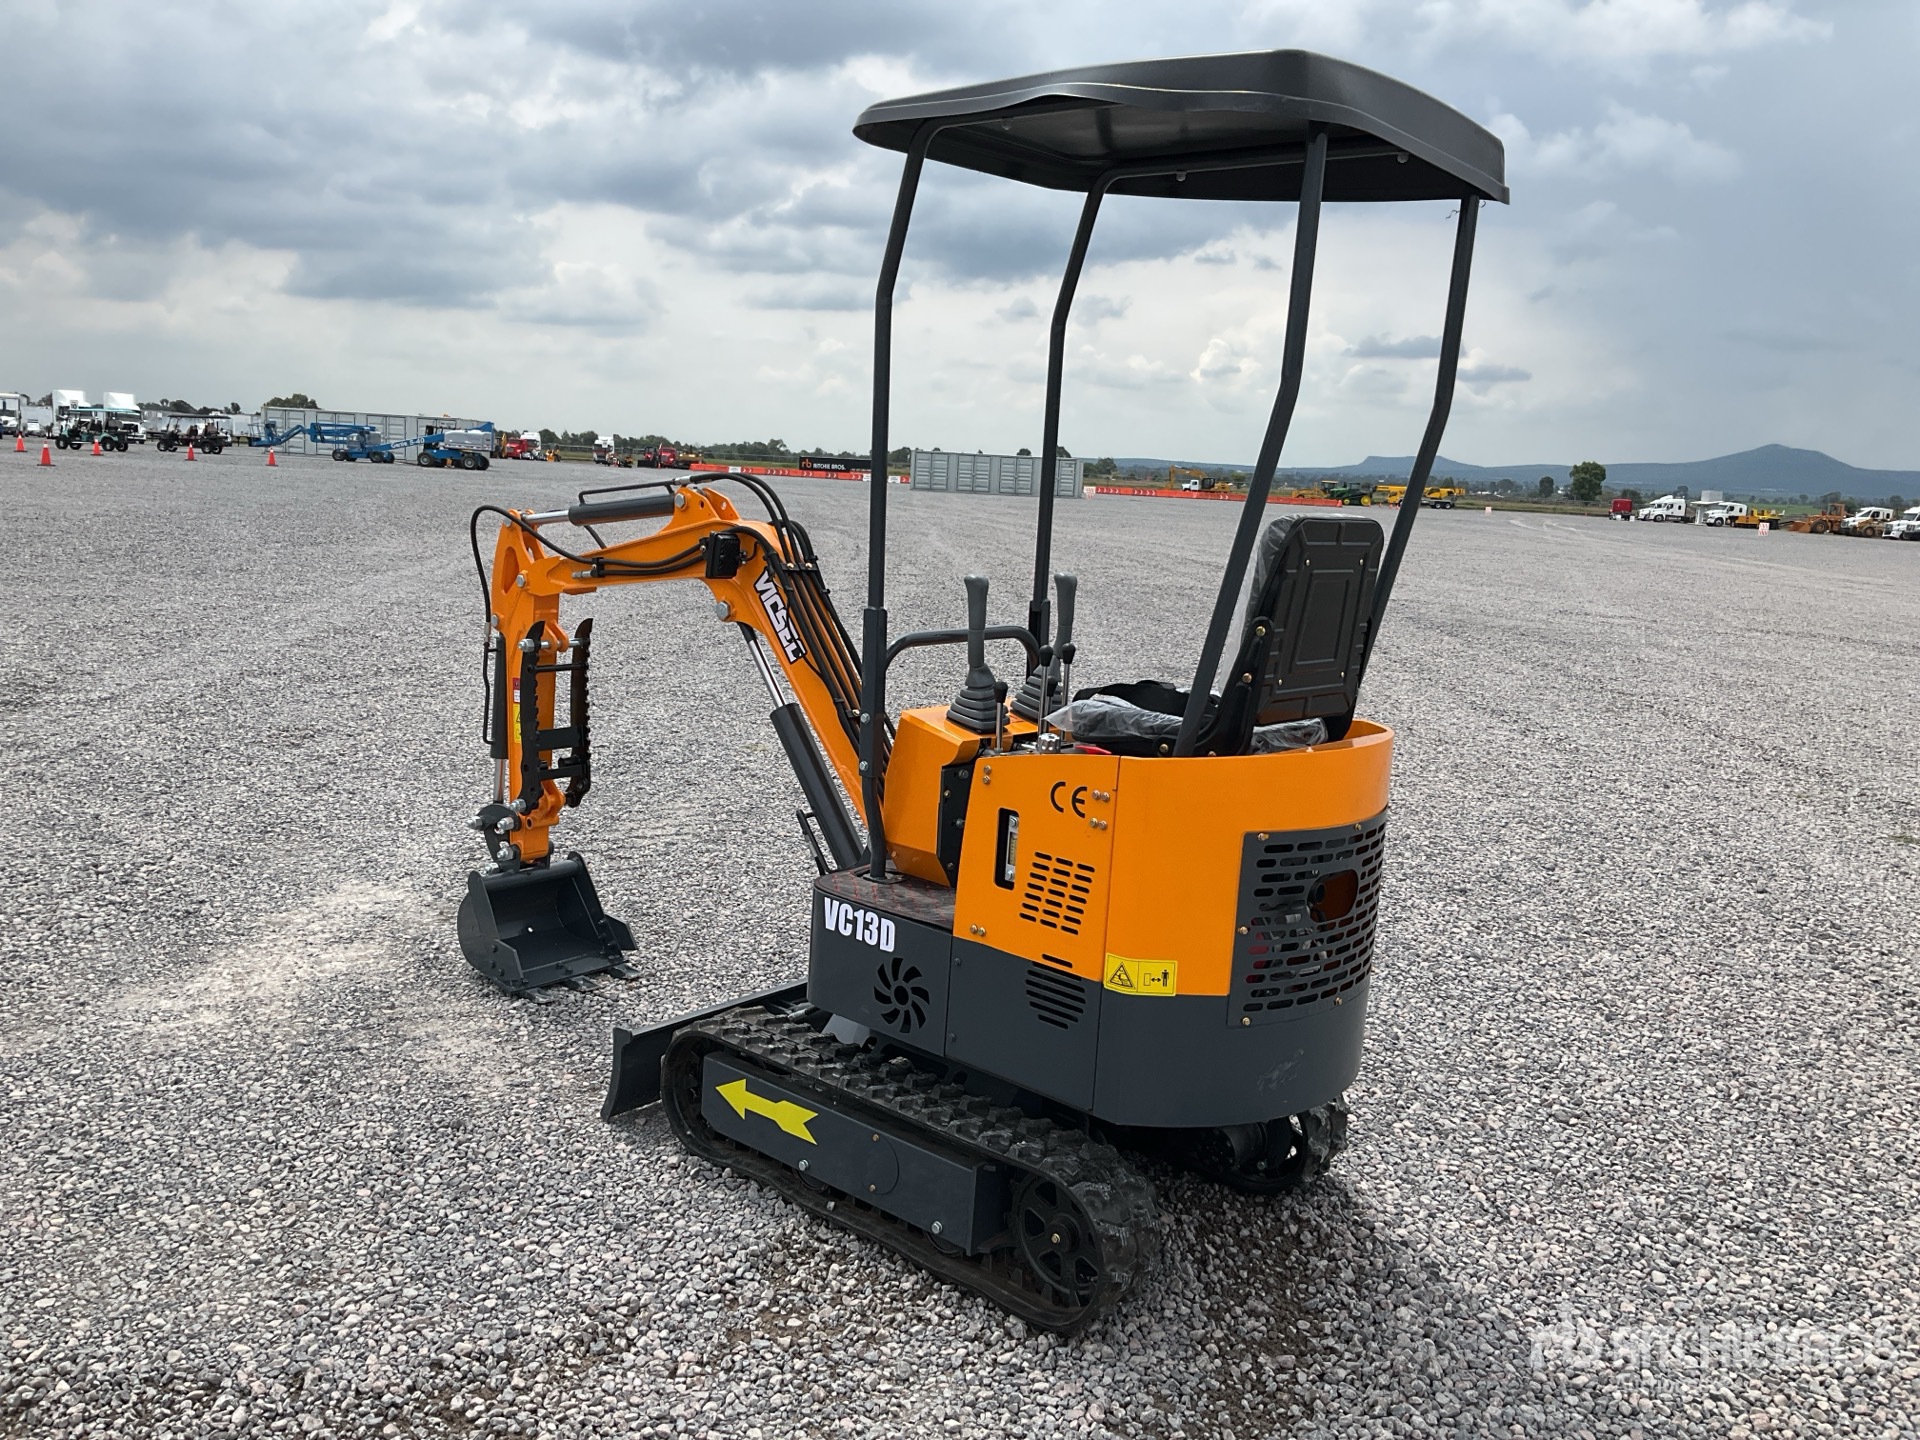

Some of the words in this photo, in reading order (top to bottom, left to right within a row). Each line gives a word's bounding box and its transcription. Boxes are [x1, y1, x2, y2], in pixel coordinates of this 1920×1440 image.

[801, 458, 812, 468] rb
[754, 569, 807, 663] VICSEC
[1050, 780, 1088, 818] CE
[824, 896, 896, 953] VC13D
